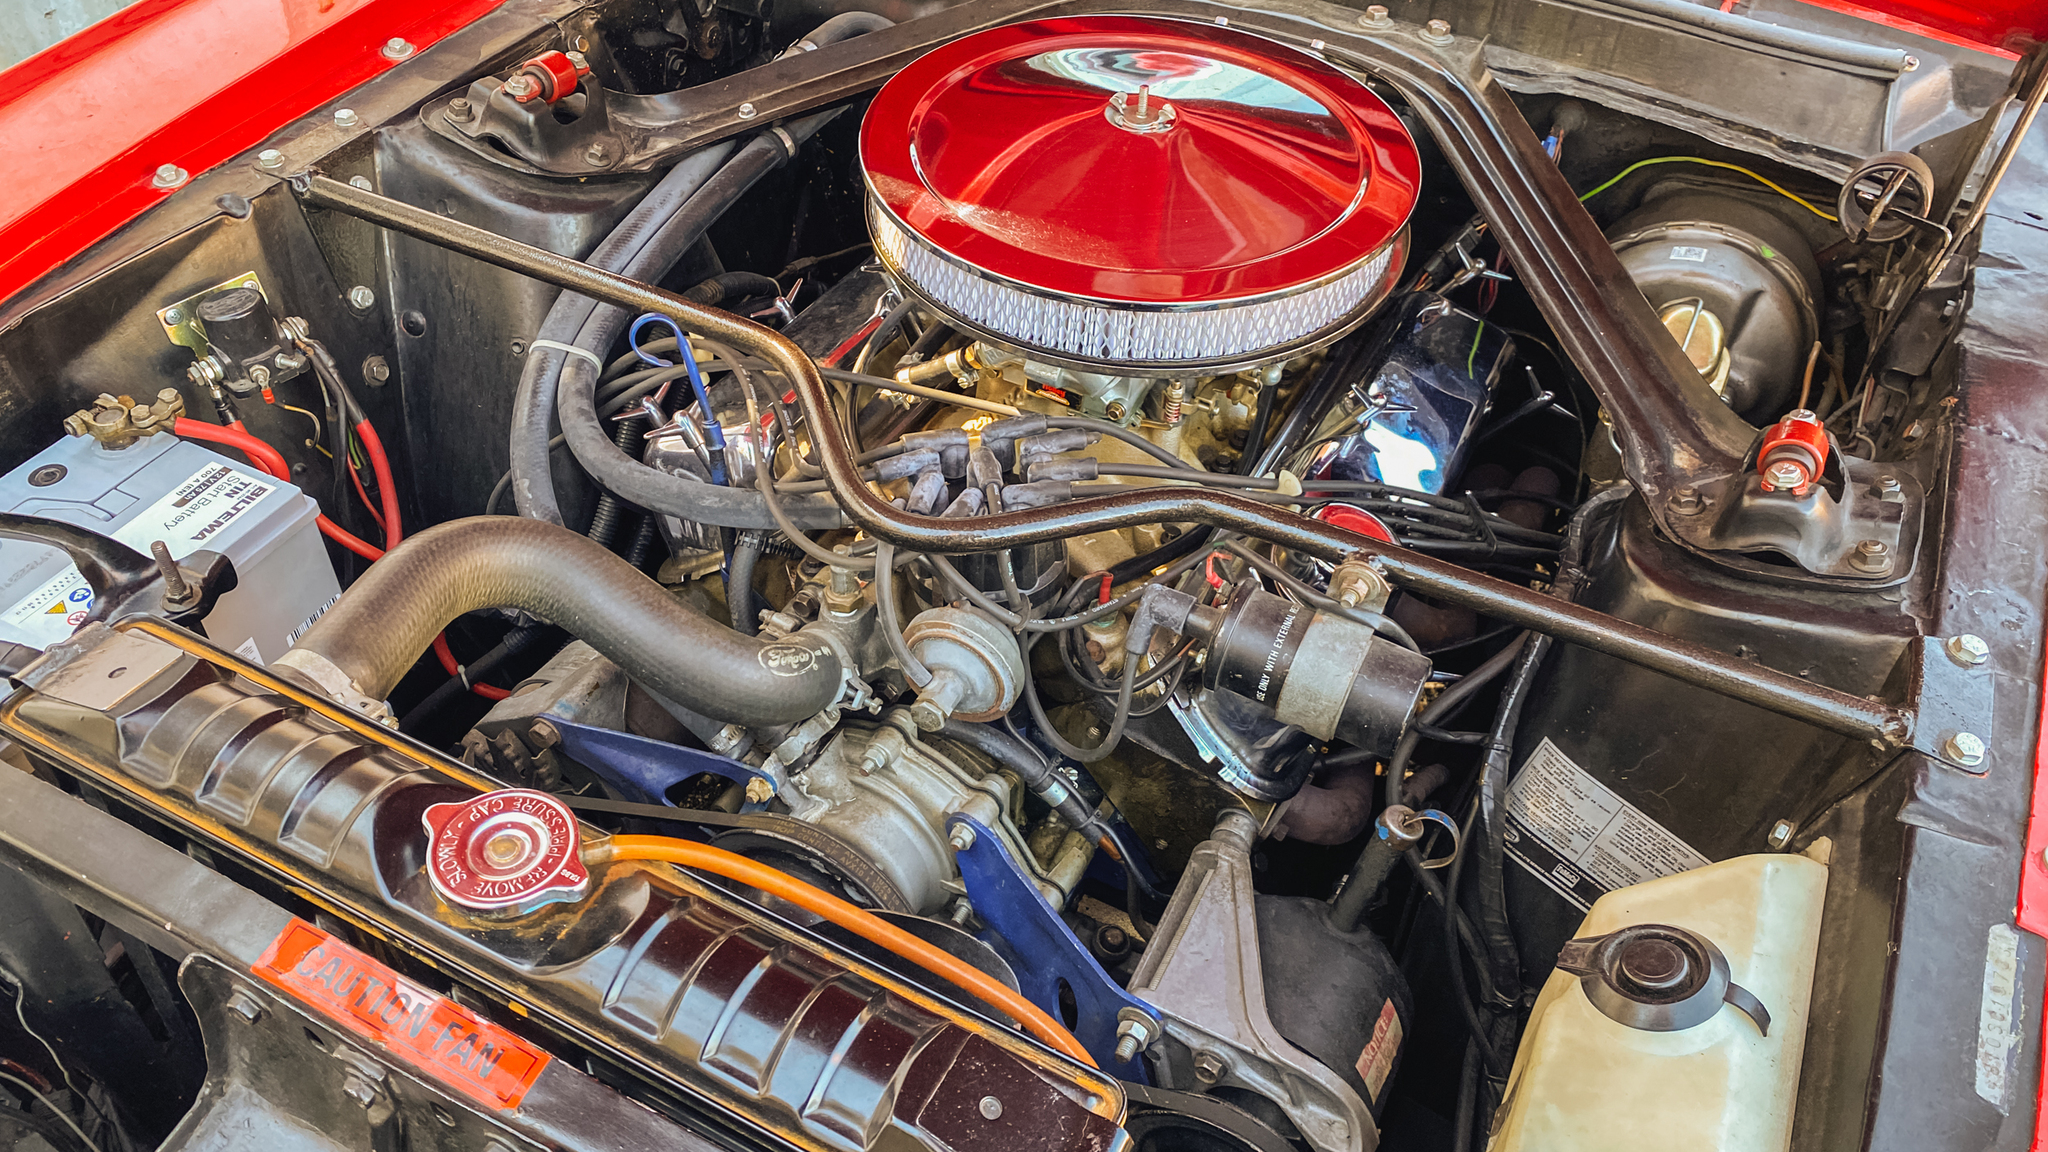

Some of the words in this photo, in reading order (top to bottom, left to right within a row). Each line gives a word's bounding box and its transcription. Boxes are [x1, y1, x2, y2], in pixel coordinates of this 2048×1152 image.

[200, 467, 216, 476] 700
[206, 475, 240, 498] Start
[224, 481, 252, 498] TIN
[164, 499, 211, 530] Battery
[190, 485, 267, 540] BILTEMA
[1272, 612, 1295, 648] EXTERNAL
[1263, 649, 1279, 672] WITH
[1257, 672, 1270, 691] ONLY
[469, 798, 505, 822] CAP
[512, 796, 568, 857] PRESSURE
[437, 829, 467, 888] SLOWLY
[796, 832, 837, 856] CONTI-SF
[838, 855, 864, 876] AVX10
[474, 866, 548, 895] REMOVE
[295, 944, 505, 1078] CAUTION-FAN
